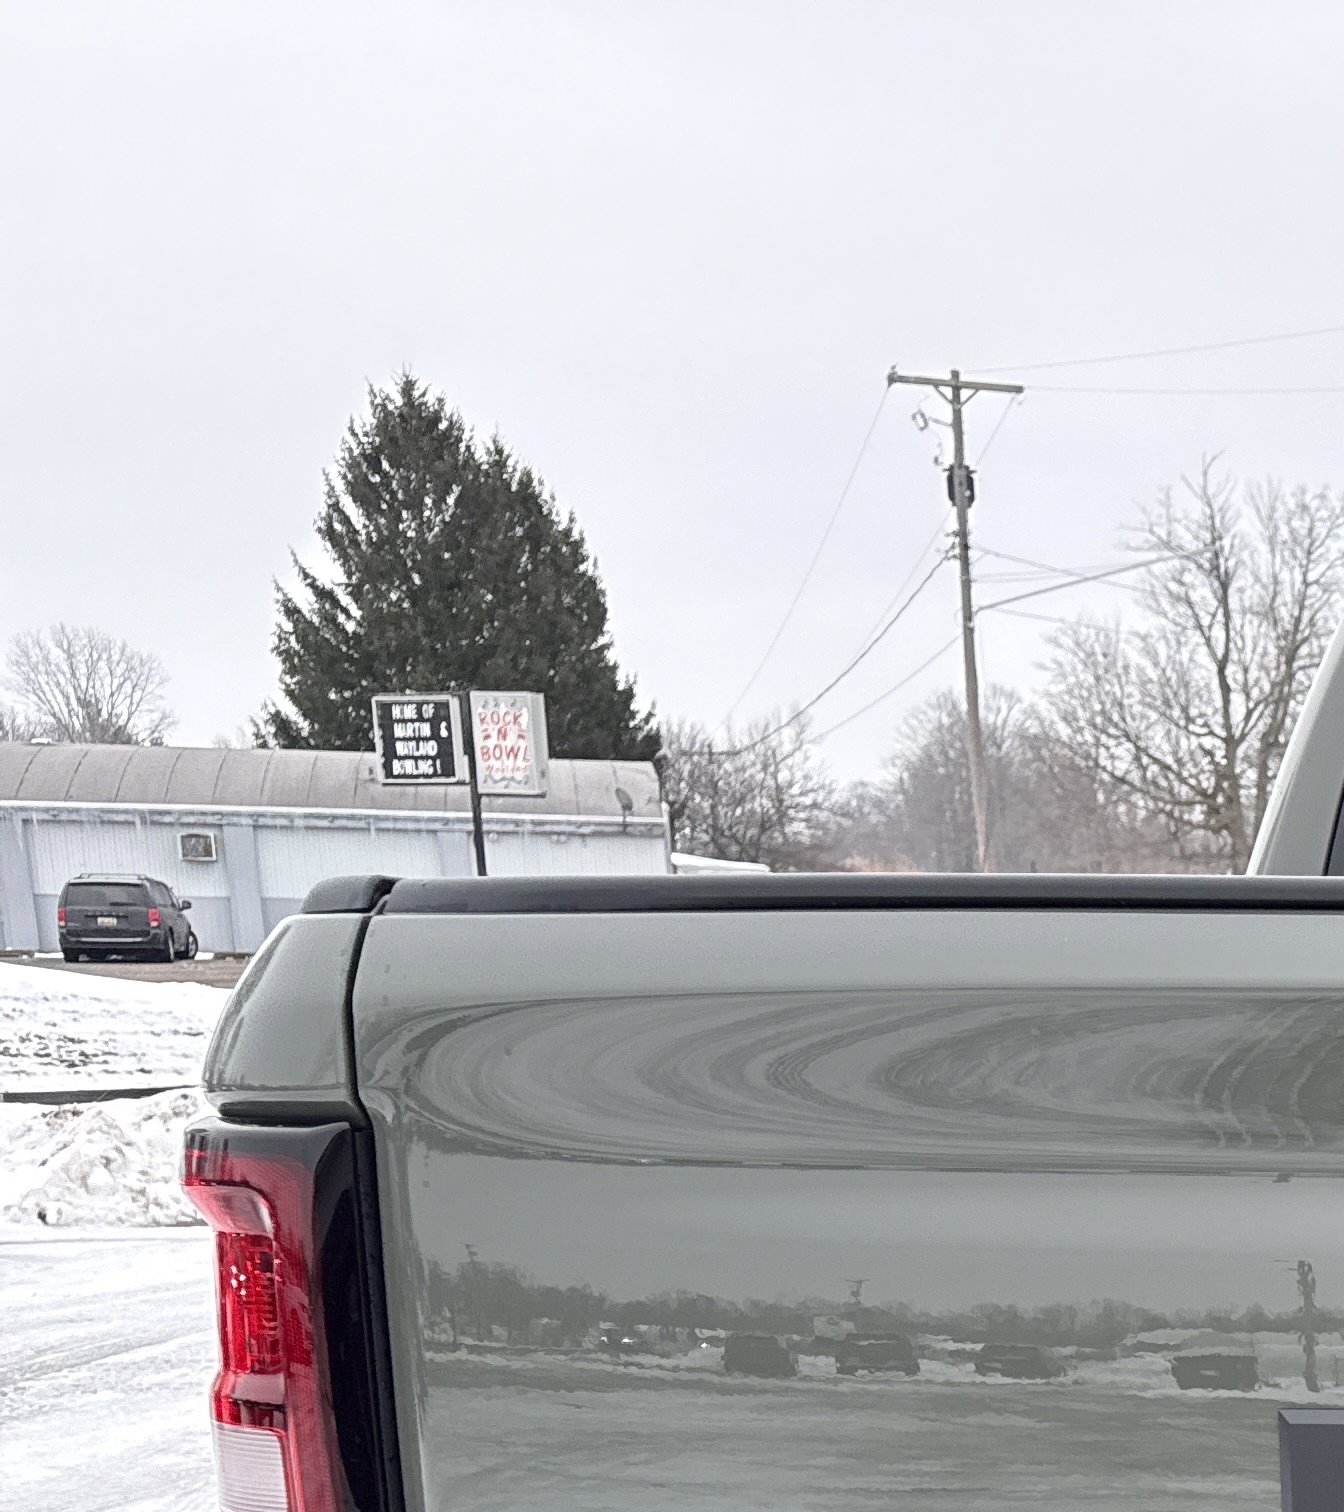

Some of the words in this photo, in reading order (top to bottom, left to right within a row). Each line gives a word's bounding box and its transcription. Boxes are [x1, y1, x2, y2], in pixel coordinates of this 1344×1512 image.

[391, 703, 418, 720] HOME
[422, 703, 435, 719] OF
[478, 710, 522, 726] ROCK
[394, 721, 431, 738] MARTIN
[440, 720, 448, 738] &
[395, 740, 438, 756] WAYLAND
[480, 743, 530, 763] BOWL
